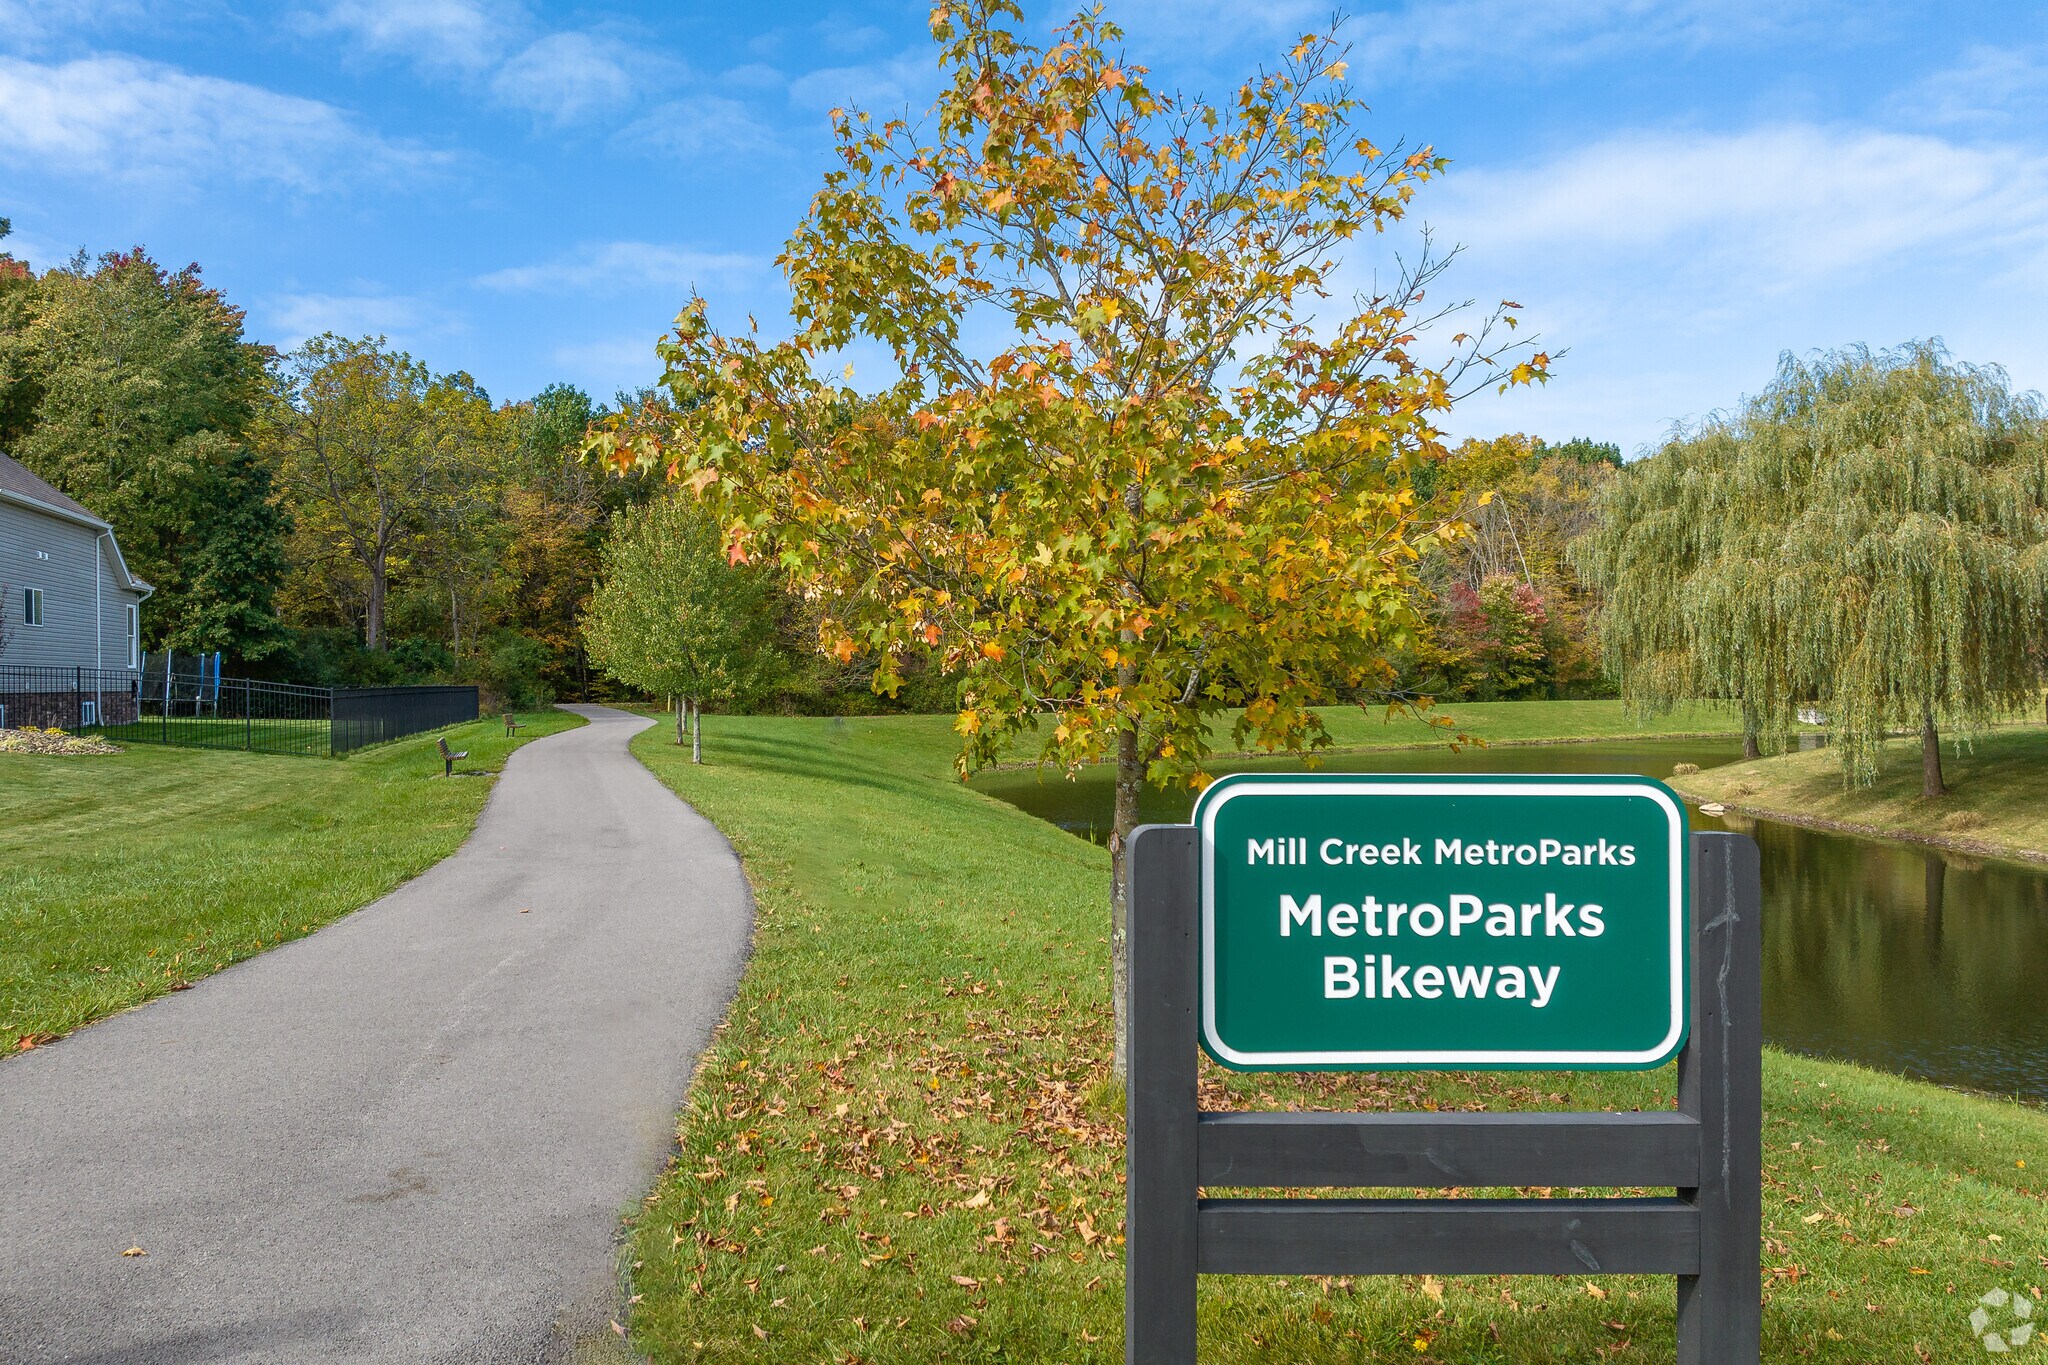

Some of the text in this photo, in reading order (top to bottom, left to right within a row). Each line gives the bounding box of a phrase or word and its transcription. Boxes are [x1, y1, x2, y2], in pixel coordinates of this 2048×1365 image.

[1248, 837, 1636, 866] Mill Creek MetroParks
[1280, 892, 1605, 937] MetroParks
[1324, 954, 1561, 1008] Bikeway
